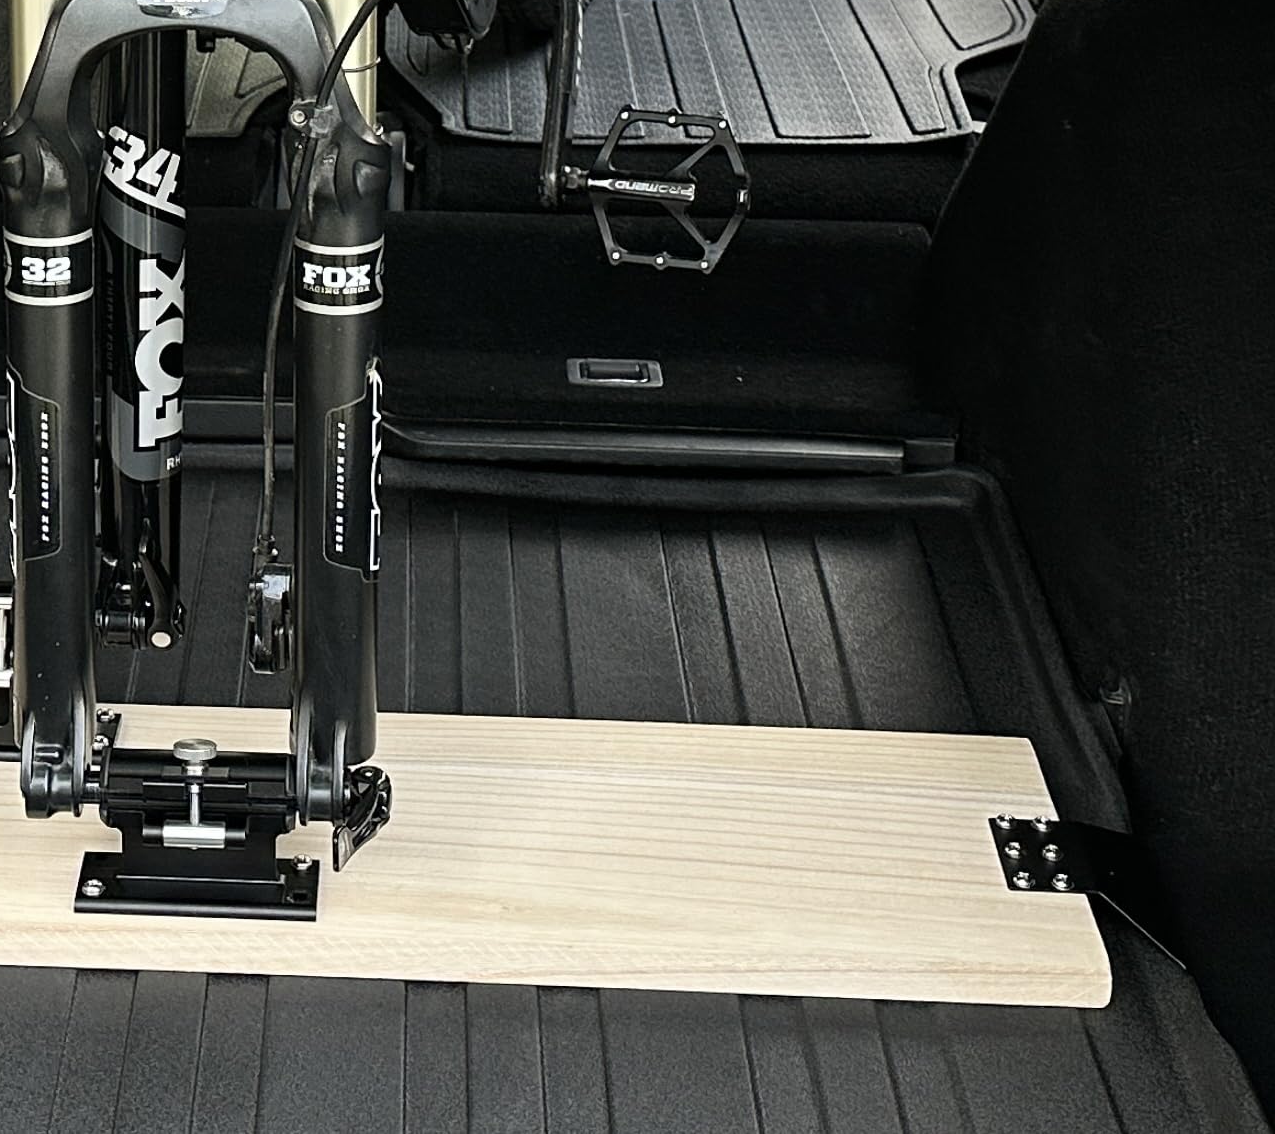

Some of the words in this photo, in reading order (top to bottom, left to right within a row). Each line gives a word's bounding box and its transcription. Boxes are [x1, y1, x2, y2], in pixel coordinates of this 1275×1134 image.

[104, 126, 185, 211] 34
[22, 257, 71, 282] 32
[303, 262, 371, 288] FOX
[135, 259, 183, 447] FOX
